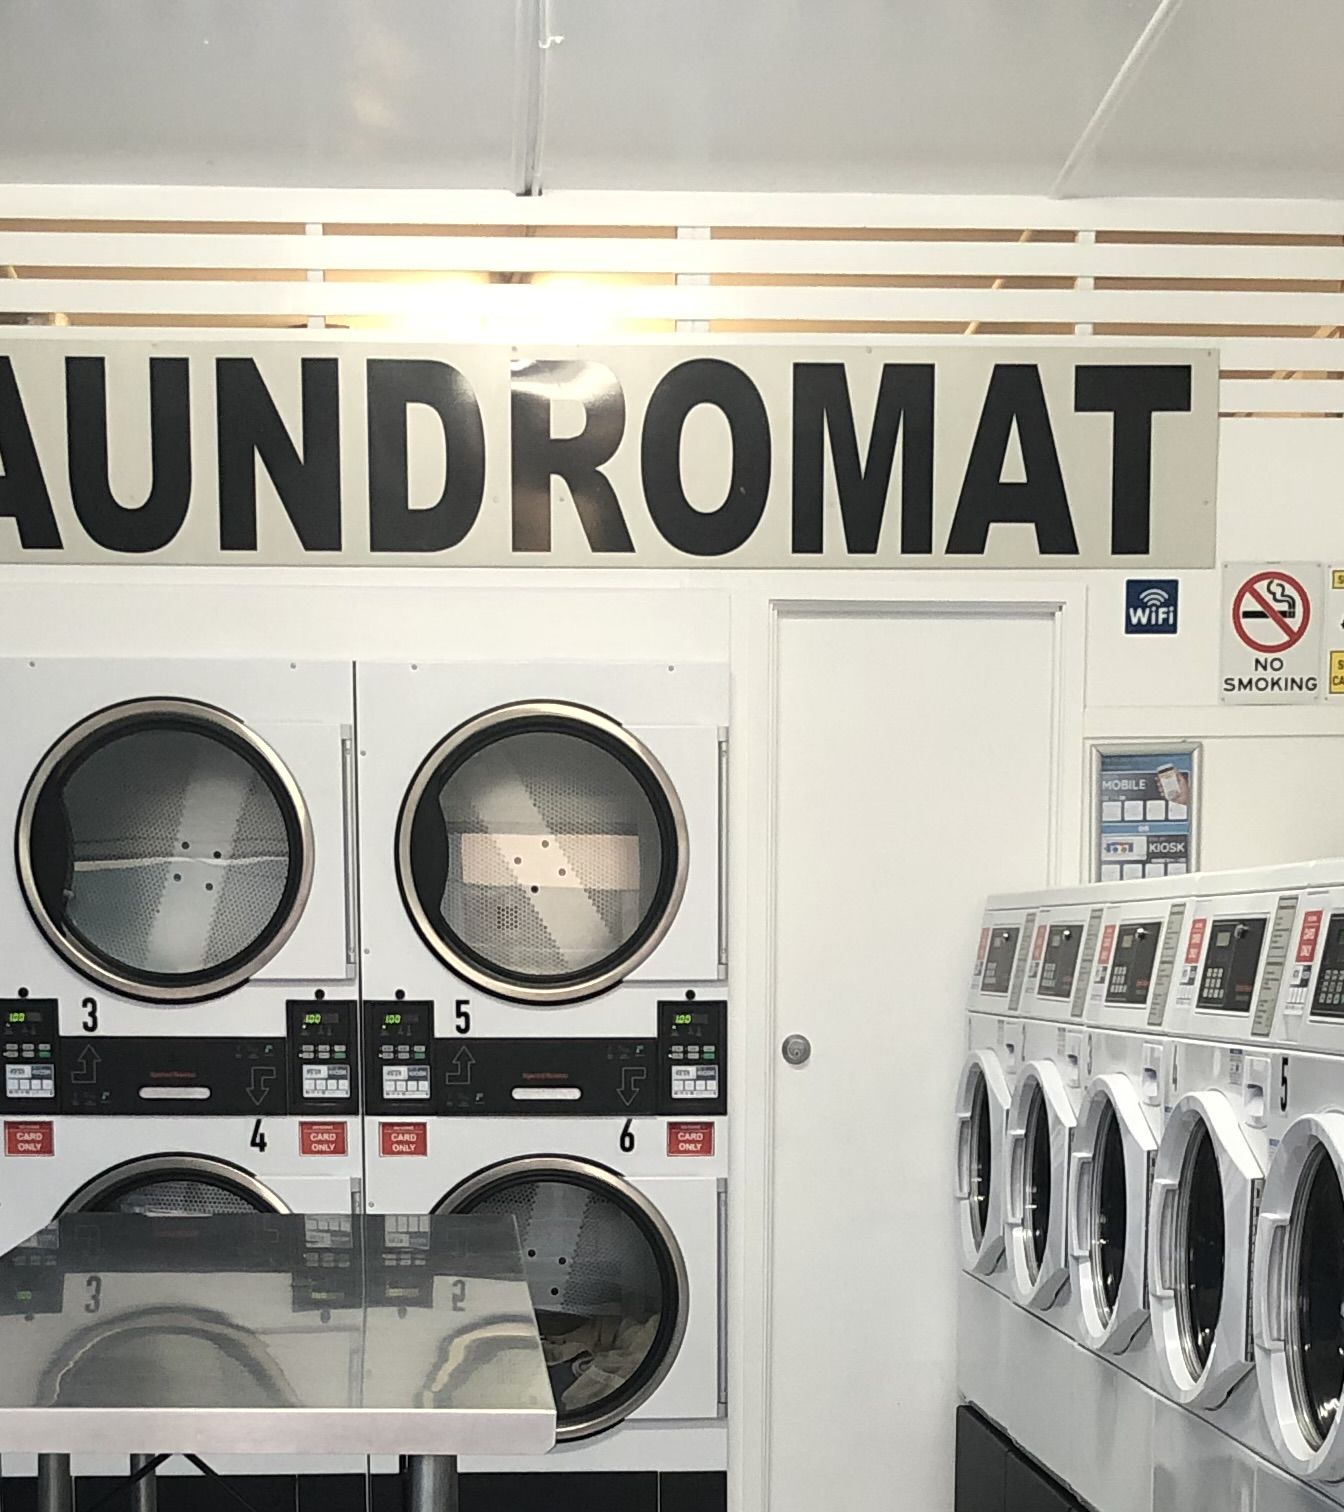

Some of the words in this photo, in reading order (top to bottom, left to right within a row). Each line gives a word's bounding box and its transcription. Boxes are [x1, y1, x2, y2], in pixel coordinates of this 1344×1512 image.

[1129, 606, 1174, 625] WiFi
[1254, 657, 1284, 672] NO
[1223, 676, 1318, 692] SMOKING
[1102, 779, 1146, 790] MOBILE
[1148, 842, 1185, 853] KIOSK
[81, 997, 98, 1032] 3
[455, 999, 471, 1034] 5
[1280, 1056, 1289, 1112] 5
[16, 1132, 43, 1141] CARD
[250, 1118, 267, 1153] 4
[310, 1133, 336, 1141] CARD
[390, 1133, 417, 1142] CARD
[619, 1118, 635, 1153] 6
[677, 1132, 703, 1141] CARD
[17, 1143, 42, 1152] ONLY
[311, 1143, 336, 1152] ONLY
[391, 1144, 416, 1153] ONLY
[678, 1142, 702, 1151] ONLY
